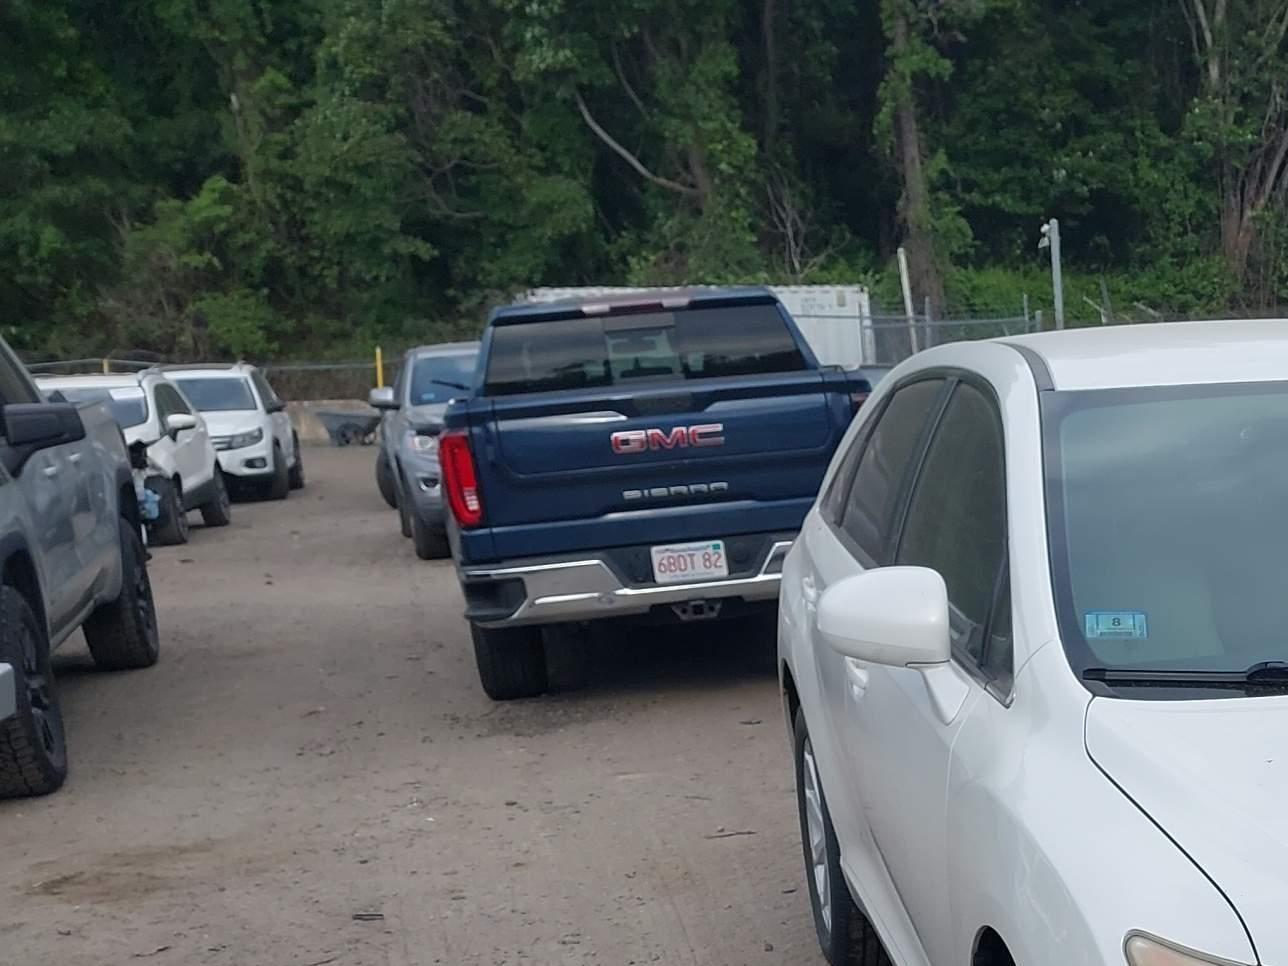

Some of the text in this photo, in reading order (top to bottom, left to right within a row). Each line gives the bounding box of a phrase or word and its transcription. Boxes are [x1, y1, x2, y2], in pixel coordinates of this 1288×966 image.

[611, 423, 724, 454] GMC
[623, 482, 728, 499] SIERRA
[702, 551, 723, 569] 82
[1111, 617, 1121, 627] 8
